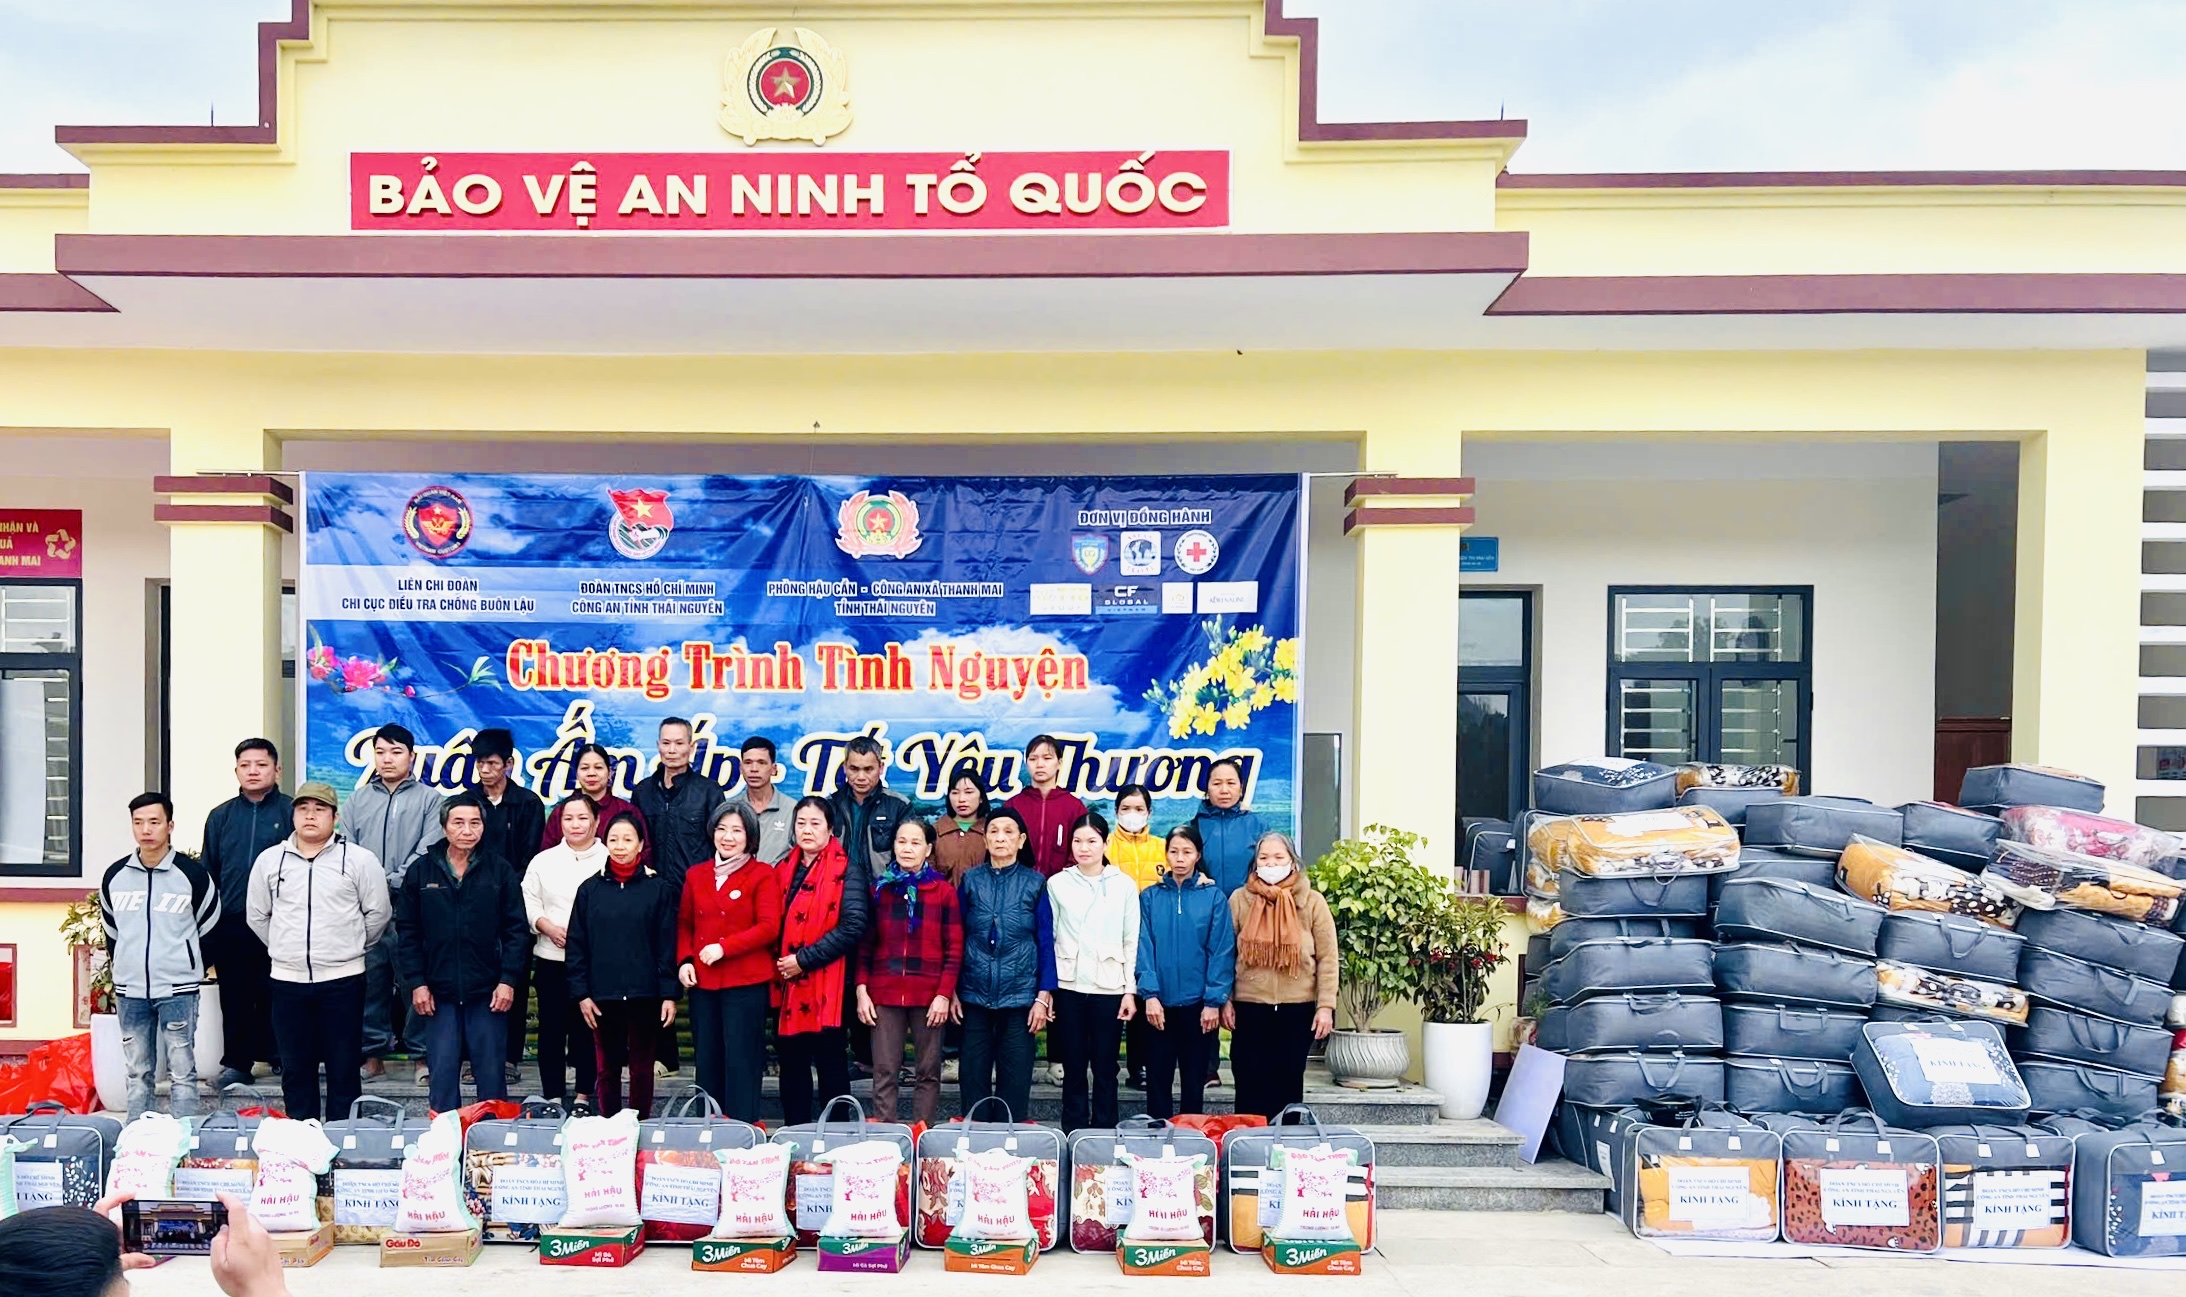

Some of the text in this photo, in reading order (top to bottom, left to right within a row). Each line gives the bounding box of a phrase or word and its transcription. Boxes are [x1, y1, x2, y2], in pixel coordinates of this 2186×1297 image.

[369, 151, 1207, 226] BẢO VỆ AN NINH TỔ QUỐC
[1079, 507, 1211, 527] ĐƠN VỊ ĐỒNG HÀNH
[26, 521, 39, 533] VÀ
[21, 556, 41, 566] MAI
[398, 577, 478, 592] LIÊN CHI ĐOÀN
[581, 580, 714, 595] ĐOÀN TNCS HỒ CHÍ MINH
[769, 580, 805, 595] PHÒNG
[808, 581, 830, 598] HẬU
[833, 579, 856, 595] CẦN
[873, 581, 902, 595] CÔNG
[906, 584, 923, 595] AN
[925, 581, 939, 595] XÃ
[942, 584, 979, 595] THANH
[981, 585, 1003, 595] MAI
[1114, 586, 1139, 597] CF
[342, 596, 534, 613] CHI CỤC ĐIỀU TRA CHỐNG BUÔN LẬU
[572, 599, 723, 614] CÔNG AN TỈNH THÁI NGUYÊN
[836, 599, 934, 614] TỈNH THÁI NGUYÊN
[510, 642, 1088, 700] Chương Trình Tình Nguyện
[261, 1194, 276, 1205] HẢI
[584, 1190, 600, 1198] HẢI
[652, 1193, 709, 1207] KÍNH TẶNG
[1680, 1194, 1739, 1205] KÍNH TẶNG
[345, 1197, 371, 1208] KÍNH
[502, 1195, 561, 1208] KÍNH TẶNG
[1833, 1198, 1897, 1210] KÍNH TẶNG
[408, 1210, 423, 1220] HẢI
[851, 1211, 867, 1221] HẢI
[1303, 1207, 1340, 1220] HẢI HẬU
[1985, 1204, 2042, 1215] KÍNH TẶNG
[735, 1213, 773, 1225] HẢI HẬU
[978, 1214, 1015, 1227] HẢI HẬU
